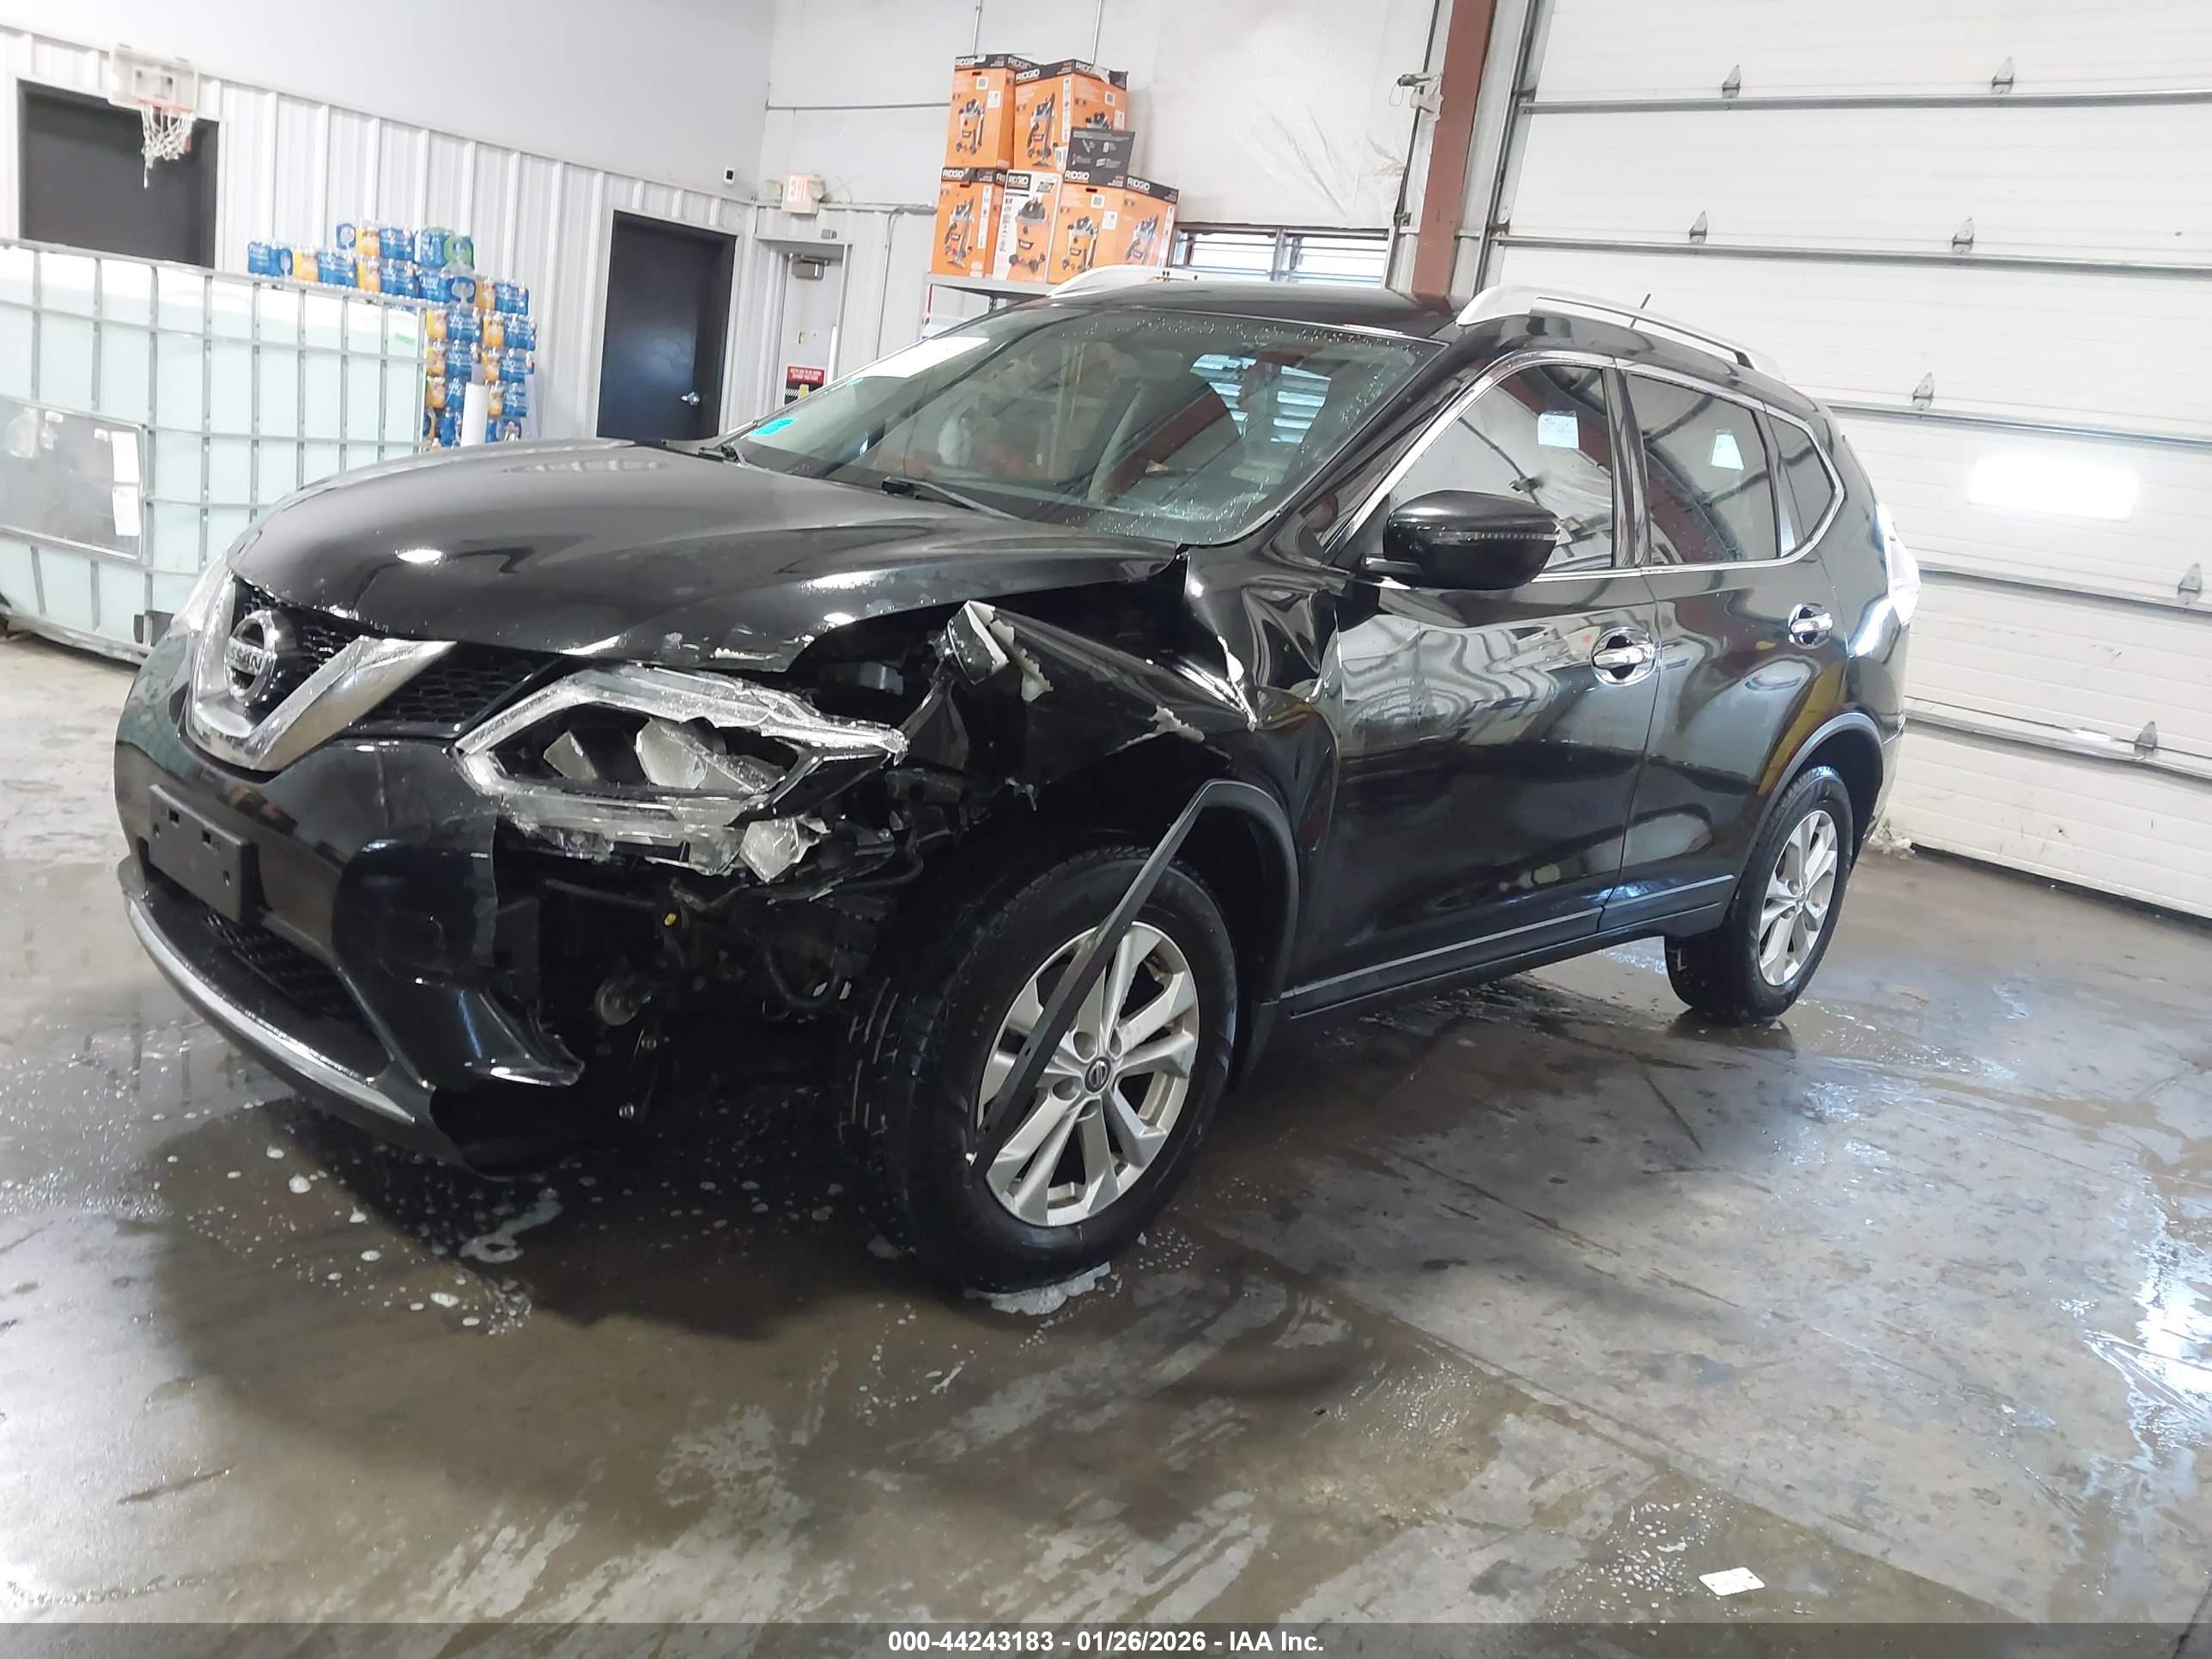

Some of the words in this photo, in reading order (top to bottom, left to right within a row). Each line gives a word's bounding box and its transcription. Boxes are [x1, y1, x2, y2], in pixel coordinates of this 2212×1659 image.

[1016, 68, 1040, 82] RIDGID
[942, 169, 964, 179] RIDGID
[1064, 170, 1091, 180] RIDGID
[1008, 175, 1030, 186] RIDGID
[1127, 177, 1151, 191] RIDGID
